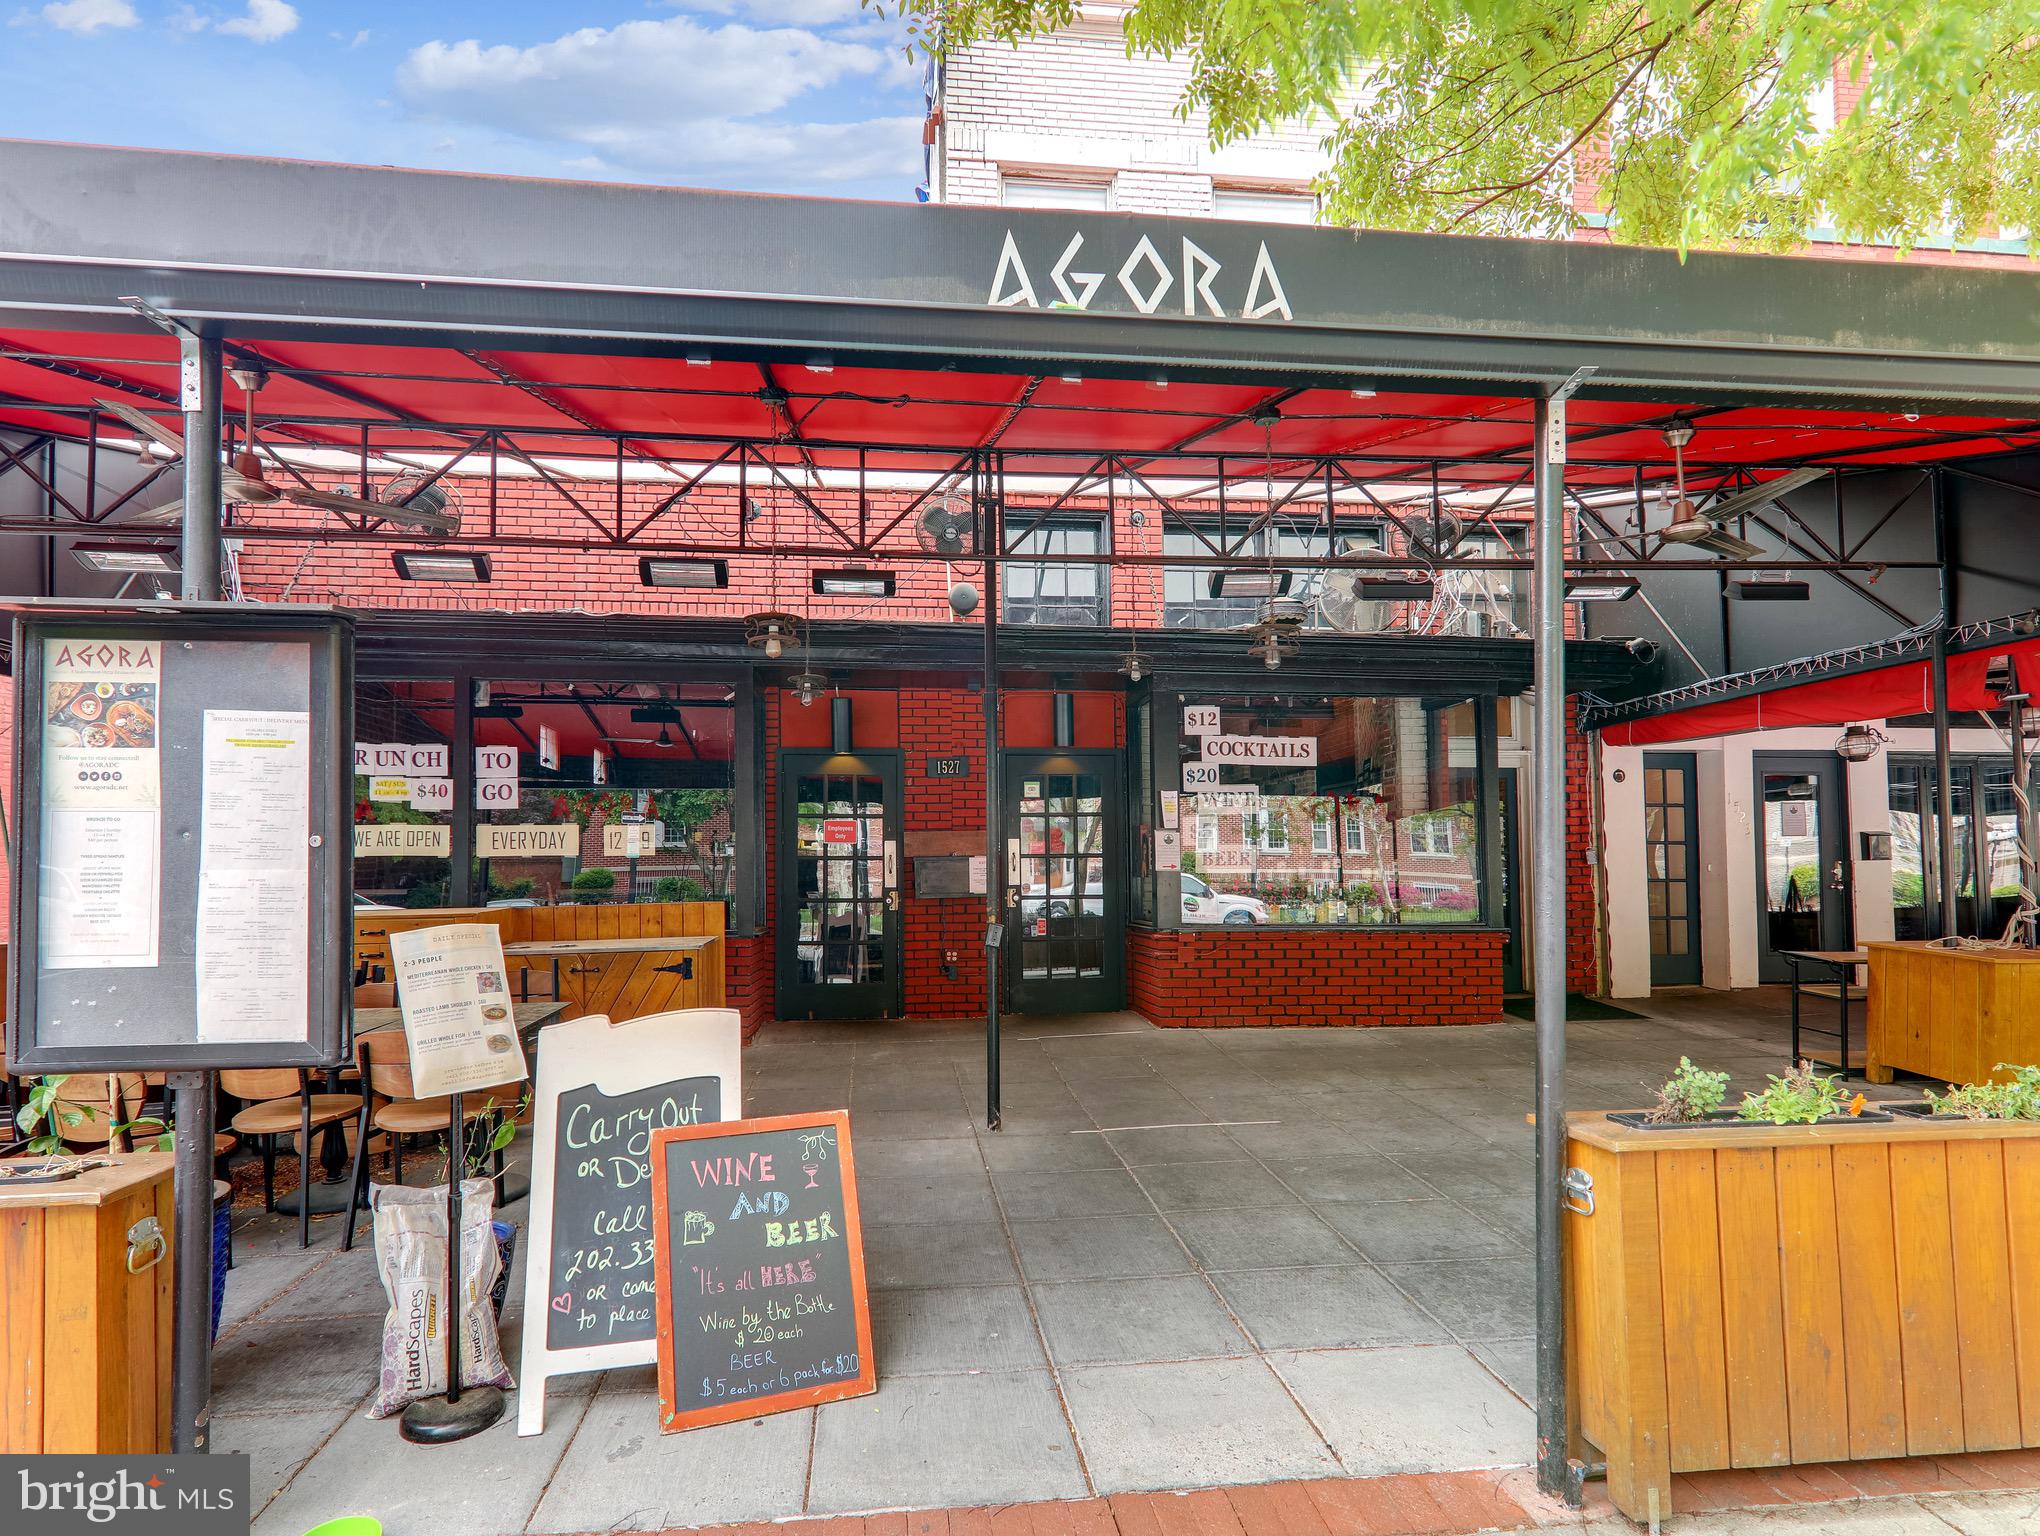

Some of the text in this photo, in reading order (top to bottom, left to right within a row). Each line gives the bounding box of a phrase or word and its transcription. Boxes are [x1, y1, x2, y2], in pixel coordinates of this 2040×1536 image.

[987, 228, 1294, 321] AGORA
[55, 644, 154, 669] AGORA
[1187, 711, 1218, 728] $12
[1206, 740, 1311, 759] COCKTAILS
[481, 752, 512, 769] TO
[936, 760, 960, 774] 1527
[1186, 767, 1217, 785] $20
[417, 782, 448, 799] $40
[482, 783, 513, 801] GO
[354, 830, 441, 847] WE ARE OPEN
[827, 825, 854, 834] Employees
[834, 832, 847, 841] Only
[492, 831, 567, 850] EVERYDAY
[609, 831, 623, 850] 12
[641, 831, 650, 850] 9
[1202, 850, 1252, 866] BEER
[432, 934, 454, 943] DAILY
[403, 955, 443, 968] 2-3 PEOPLE
[412, 1006, 435, 1016] ROASTED
[435, 1003, 451, 1012] LAMB
[416, 1036, 438, 1047] GRILLED
[566, 1093, 704, 1156] Carry Out
[608, 1156, 653, 1189] De
[690, 1152, 776, 1188] WINE
[729, 1191, 790, 1221] AND
[593, 1204, 648, 1236] Call
[765, 1210, 840, 1248] BEER
[564, 1239, 655, 1283] 202.33
[735, 1269, 756, 1292] all
[576, 1305, 652, 1336] to place
[699, 1293, 837, 1333] Wine by the Bottle
[406, 1288, 424, 1393] HardScapes
[467, 1311, 483, 1364] HardScap
[777, 1324, 804, 1340] each
[730, 1350, 777, 1371] BEER
[729, 1378, 759, 1396] each
[762, 1378, 775, 1390] or
[779, 1368, 790, 1388] 6
[793, 1363, 820, 1386] pack
[820, 1359, 834, 1375] for
[834, 1353, 859, 1376] $20
